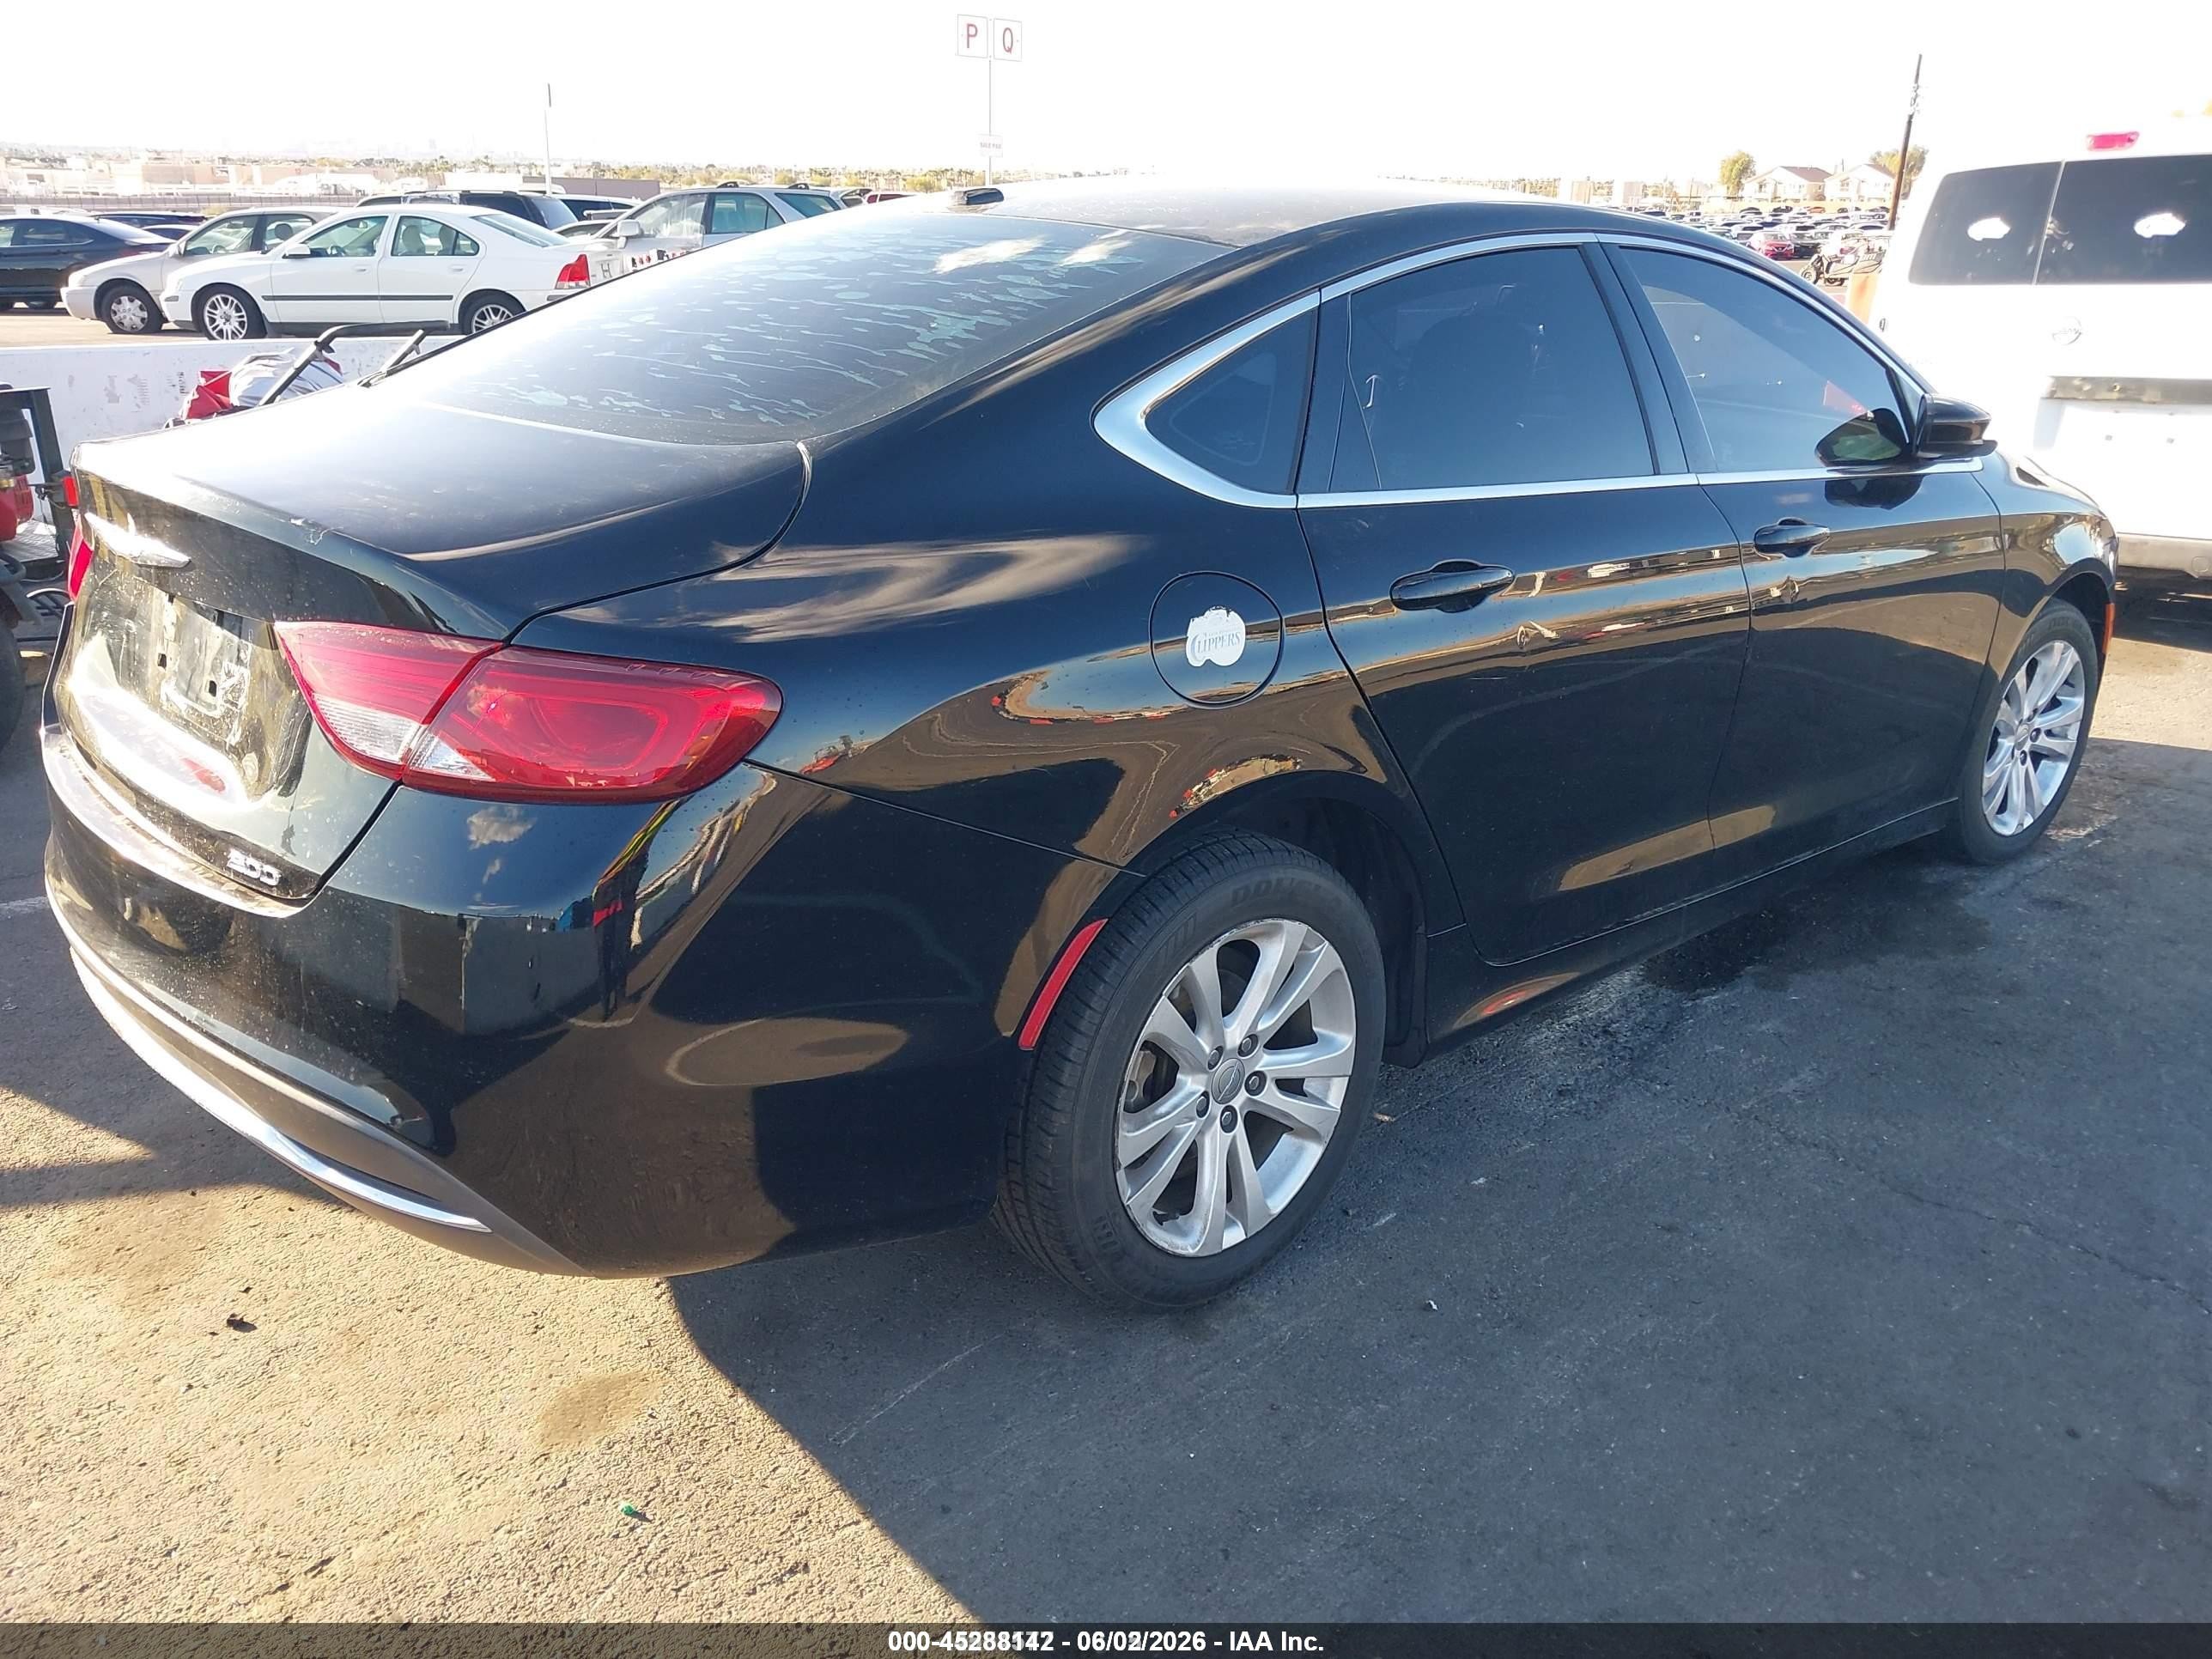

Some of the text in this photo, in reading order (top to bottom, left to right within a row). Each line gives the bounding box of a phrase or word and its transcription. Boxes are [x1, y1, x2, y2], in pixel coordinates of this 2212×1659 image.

[967, 23, 978, 48] P
[1003, 27, 1013, 54] Q
[1191, 632, 1241, 661] CLIPPERS
[227, 848, 282, 885] 200
